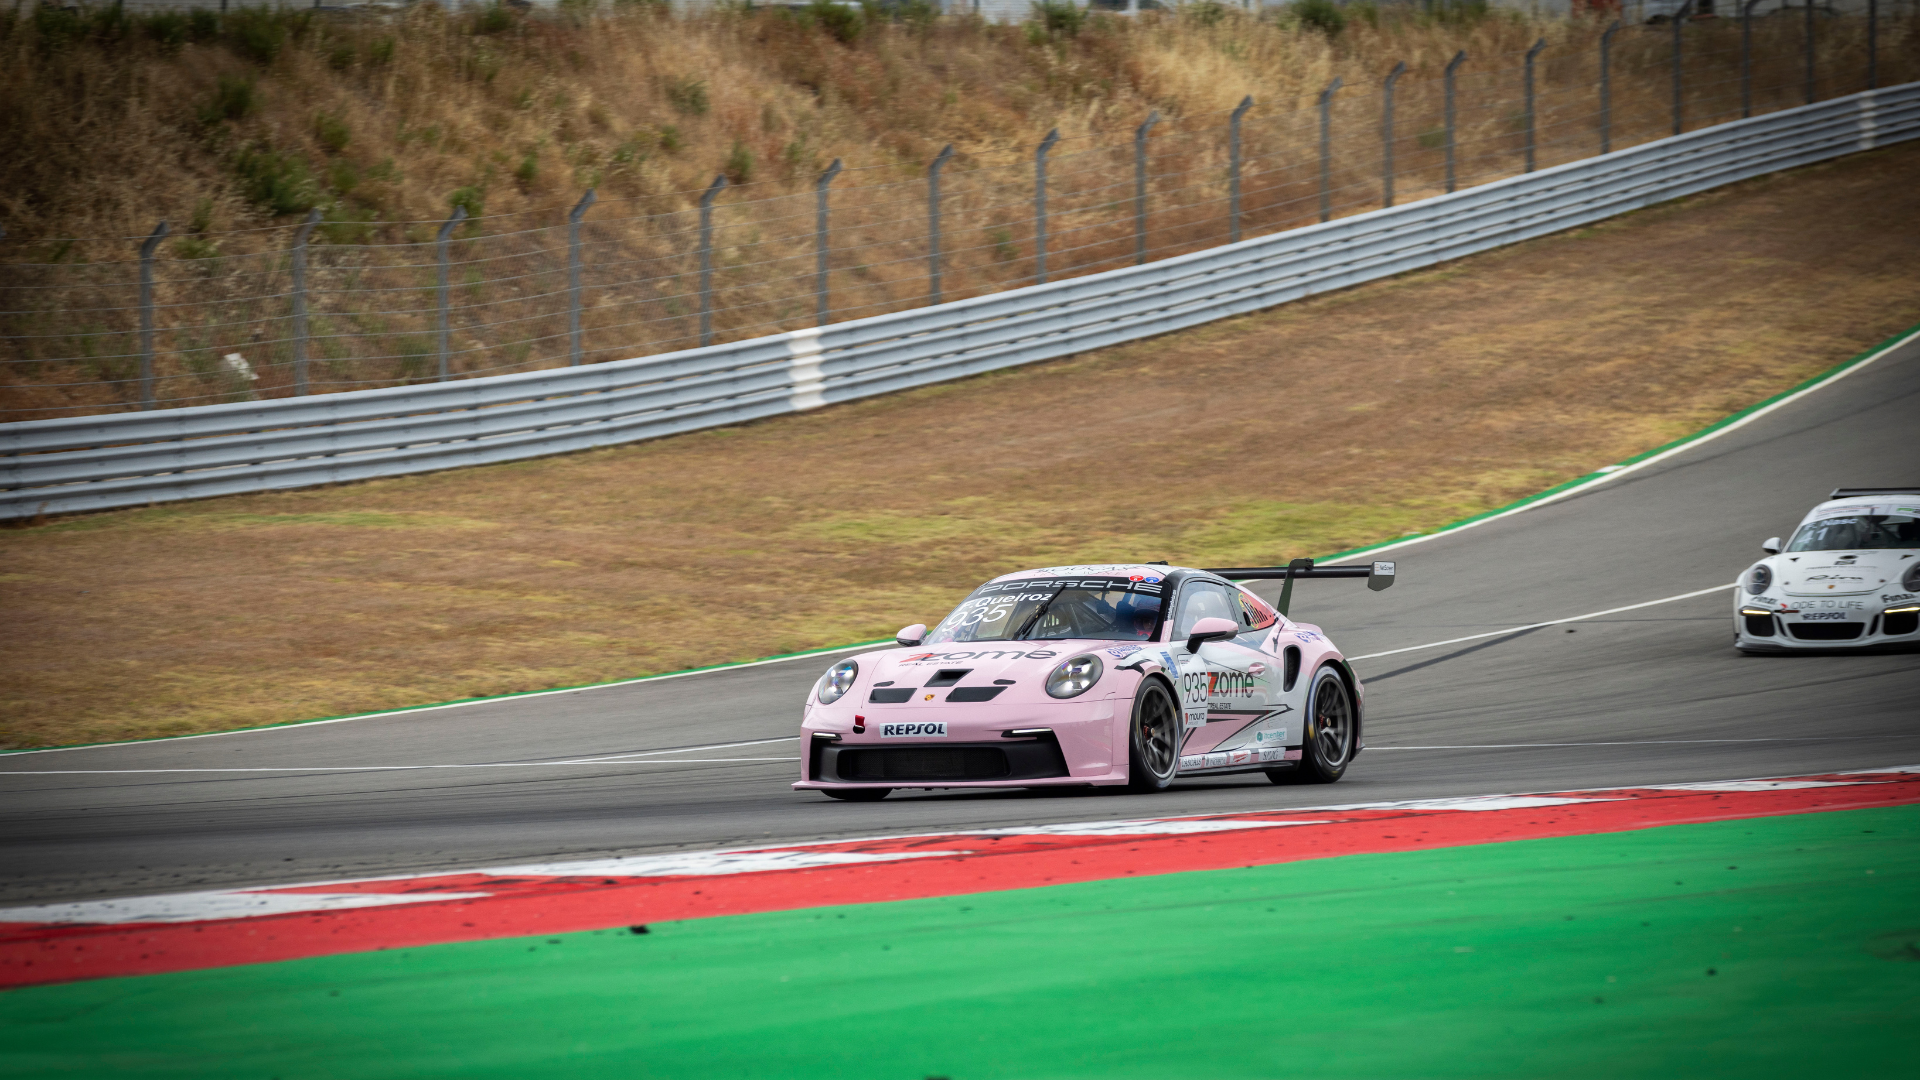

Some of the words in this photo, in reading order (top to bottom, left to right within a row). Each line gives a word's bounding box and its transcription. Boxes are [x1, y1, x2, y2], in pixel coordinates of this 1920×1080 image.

[1797, 527, 1829, 544] 41
[978, 580, 1163, 596] PORSCHE
[1821, 600, 1836, 609] TO
[1838, 600, 1864, 610] LIFE
[942, 603, 1014, 633] 935
[1183, 671, 1208, 704] 935
[1207, 671, 1255, 698] zome
[883, 722, 945, 736] REPSOL
